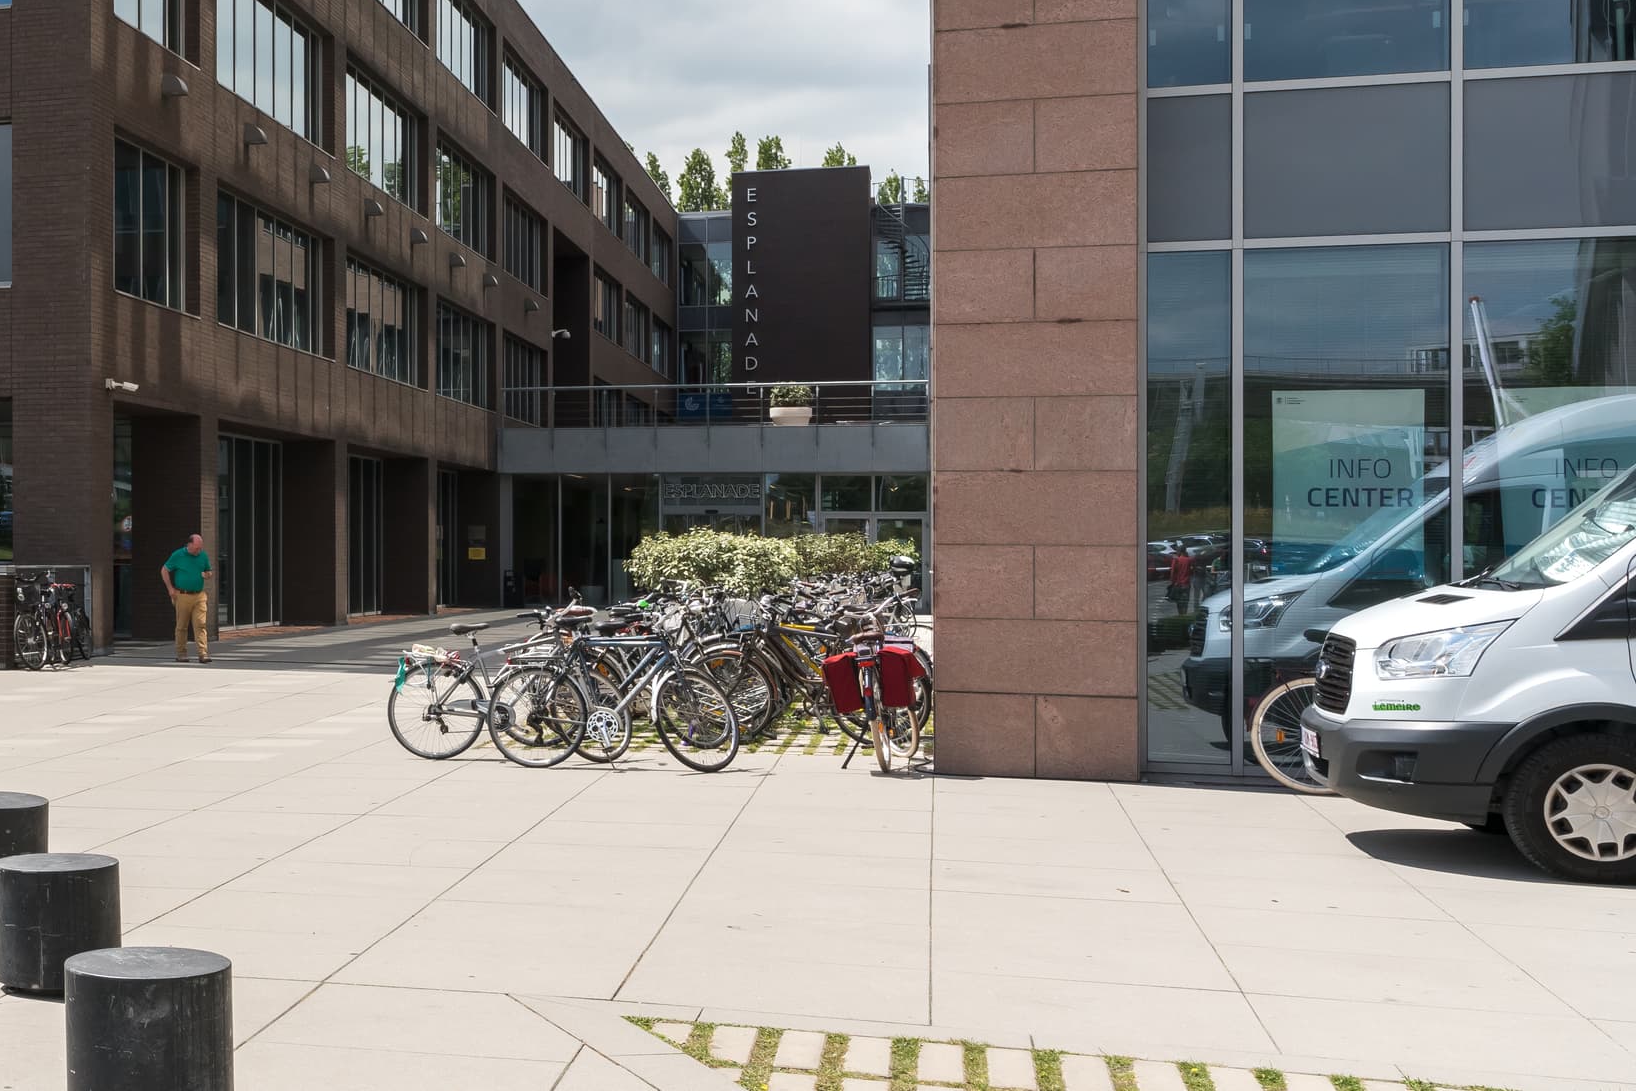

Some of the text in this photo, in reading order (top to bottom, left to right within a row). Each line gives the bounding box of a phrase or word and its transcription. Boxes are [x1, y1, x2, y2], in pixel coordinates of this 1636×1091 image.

[745, 188, 759, 395] ESPLANADE
[1329, 458, 1391, 479] INFO
[1554, 458, 1618, 479] INFO
[664, 484, 760, 498] ESPLANADE
[1307, 487, 1414, 508] CENTER
